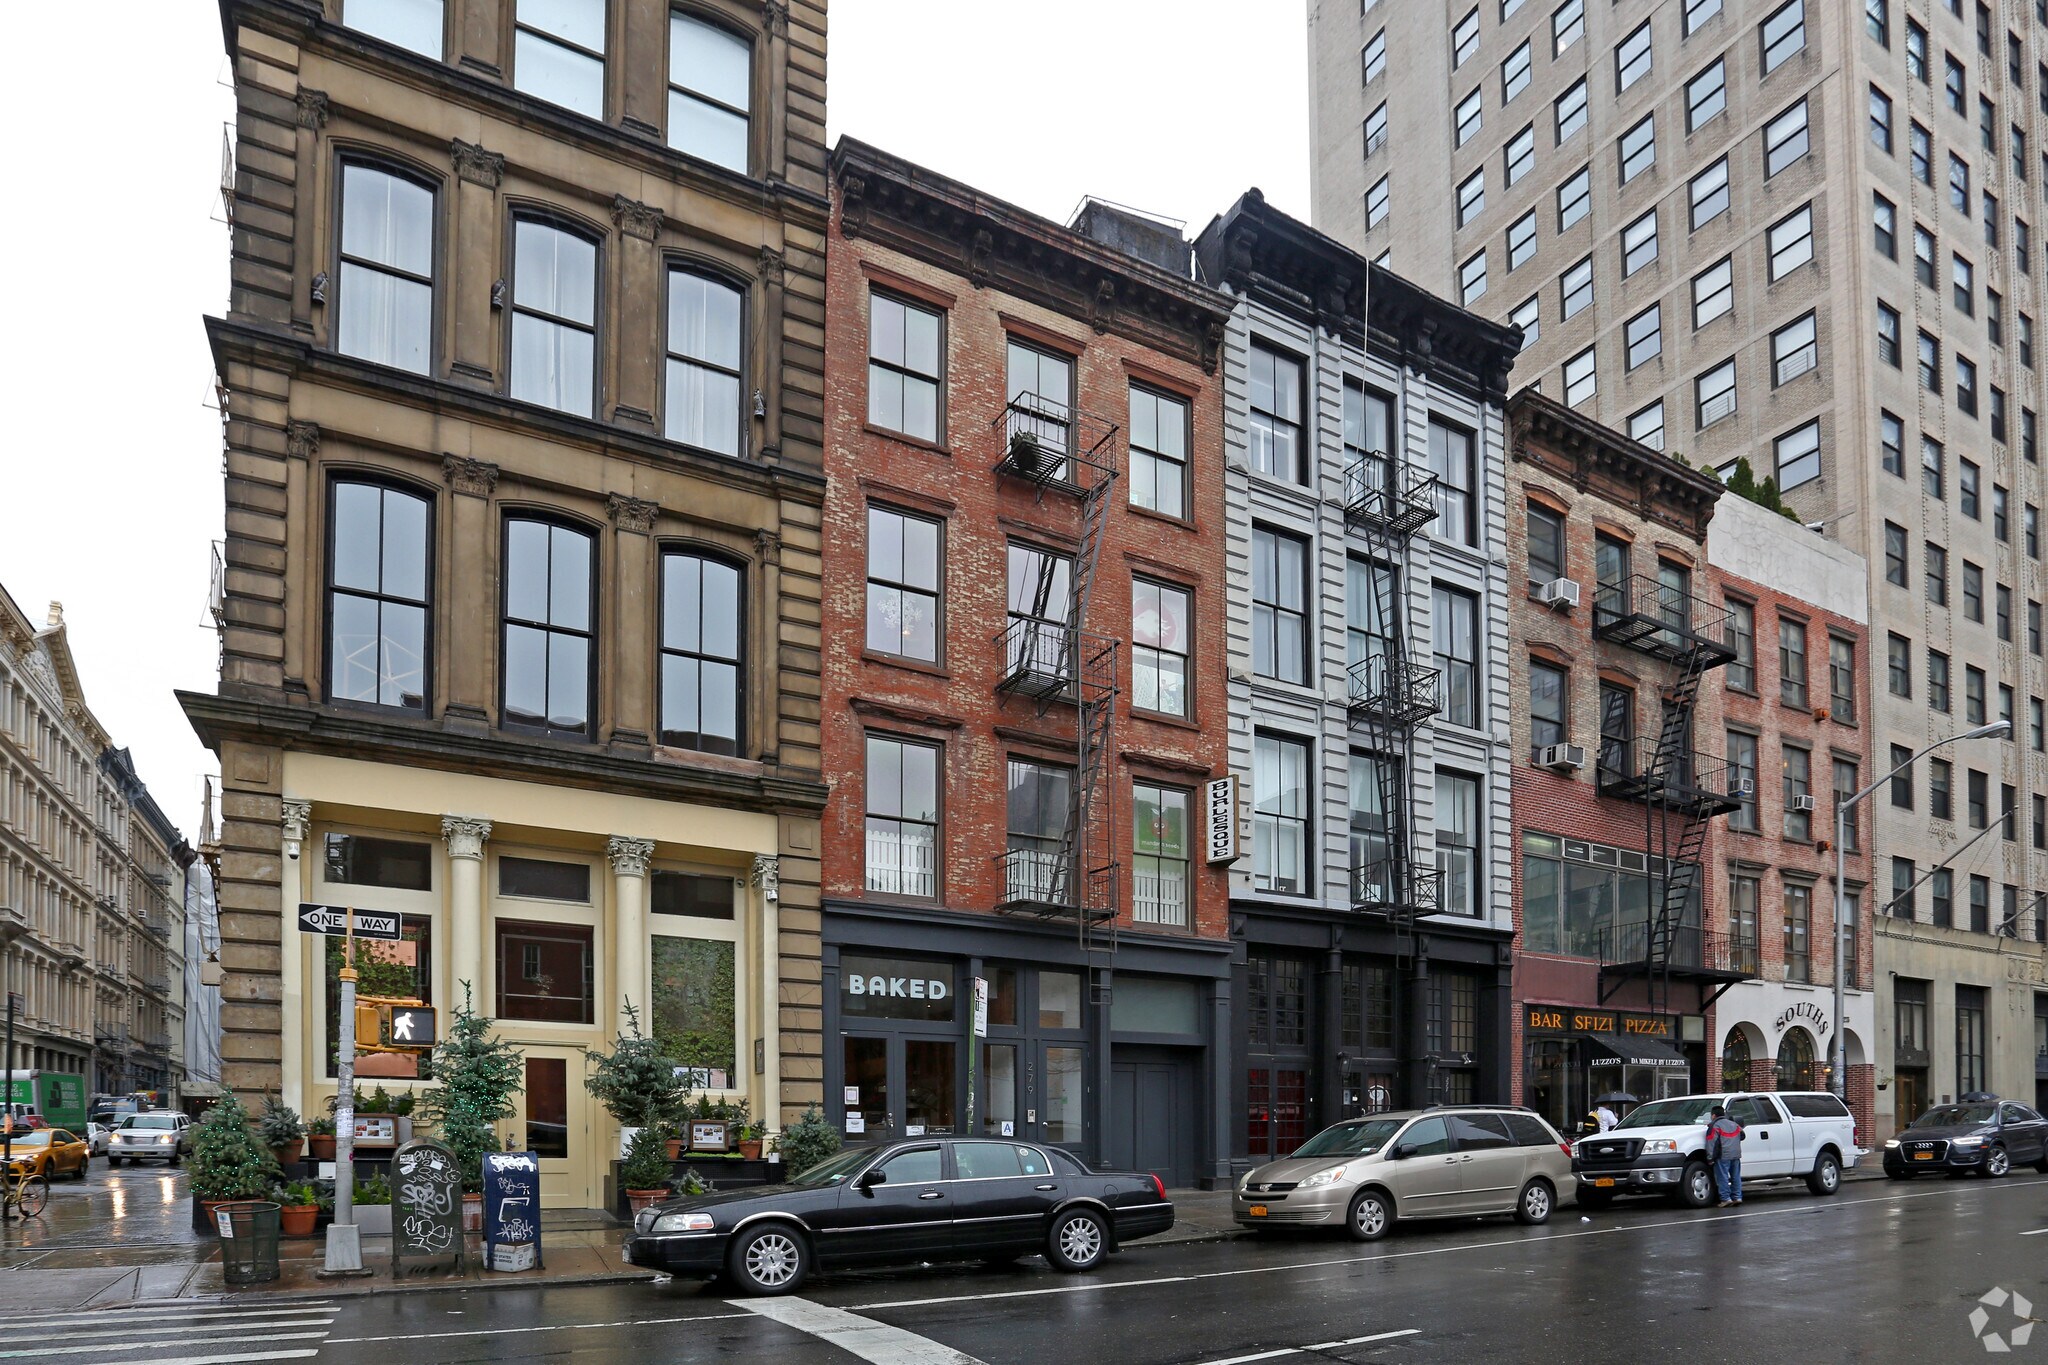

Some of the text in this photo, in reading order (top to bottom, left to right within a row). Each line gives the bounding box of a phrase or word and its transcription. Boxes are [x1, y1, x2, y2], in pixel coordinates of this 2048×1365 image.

[1212, 781, 1229, 858] BURLESQUE
[309, 912, 391, 930] ONE WAY
[849, 974, 947, 1000] BAKED
[1530, 1012, 1667, 1035] BAR SFIZI PIZZA
[1776, 1002, 1828, 1034] SOUTHS
[1591, 1057, 1621, 1066] LUZZO'S
[1003, 1123, 1012, 1133] A
